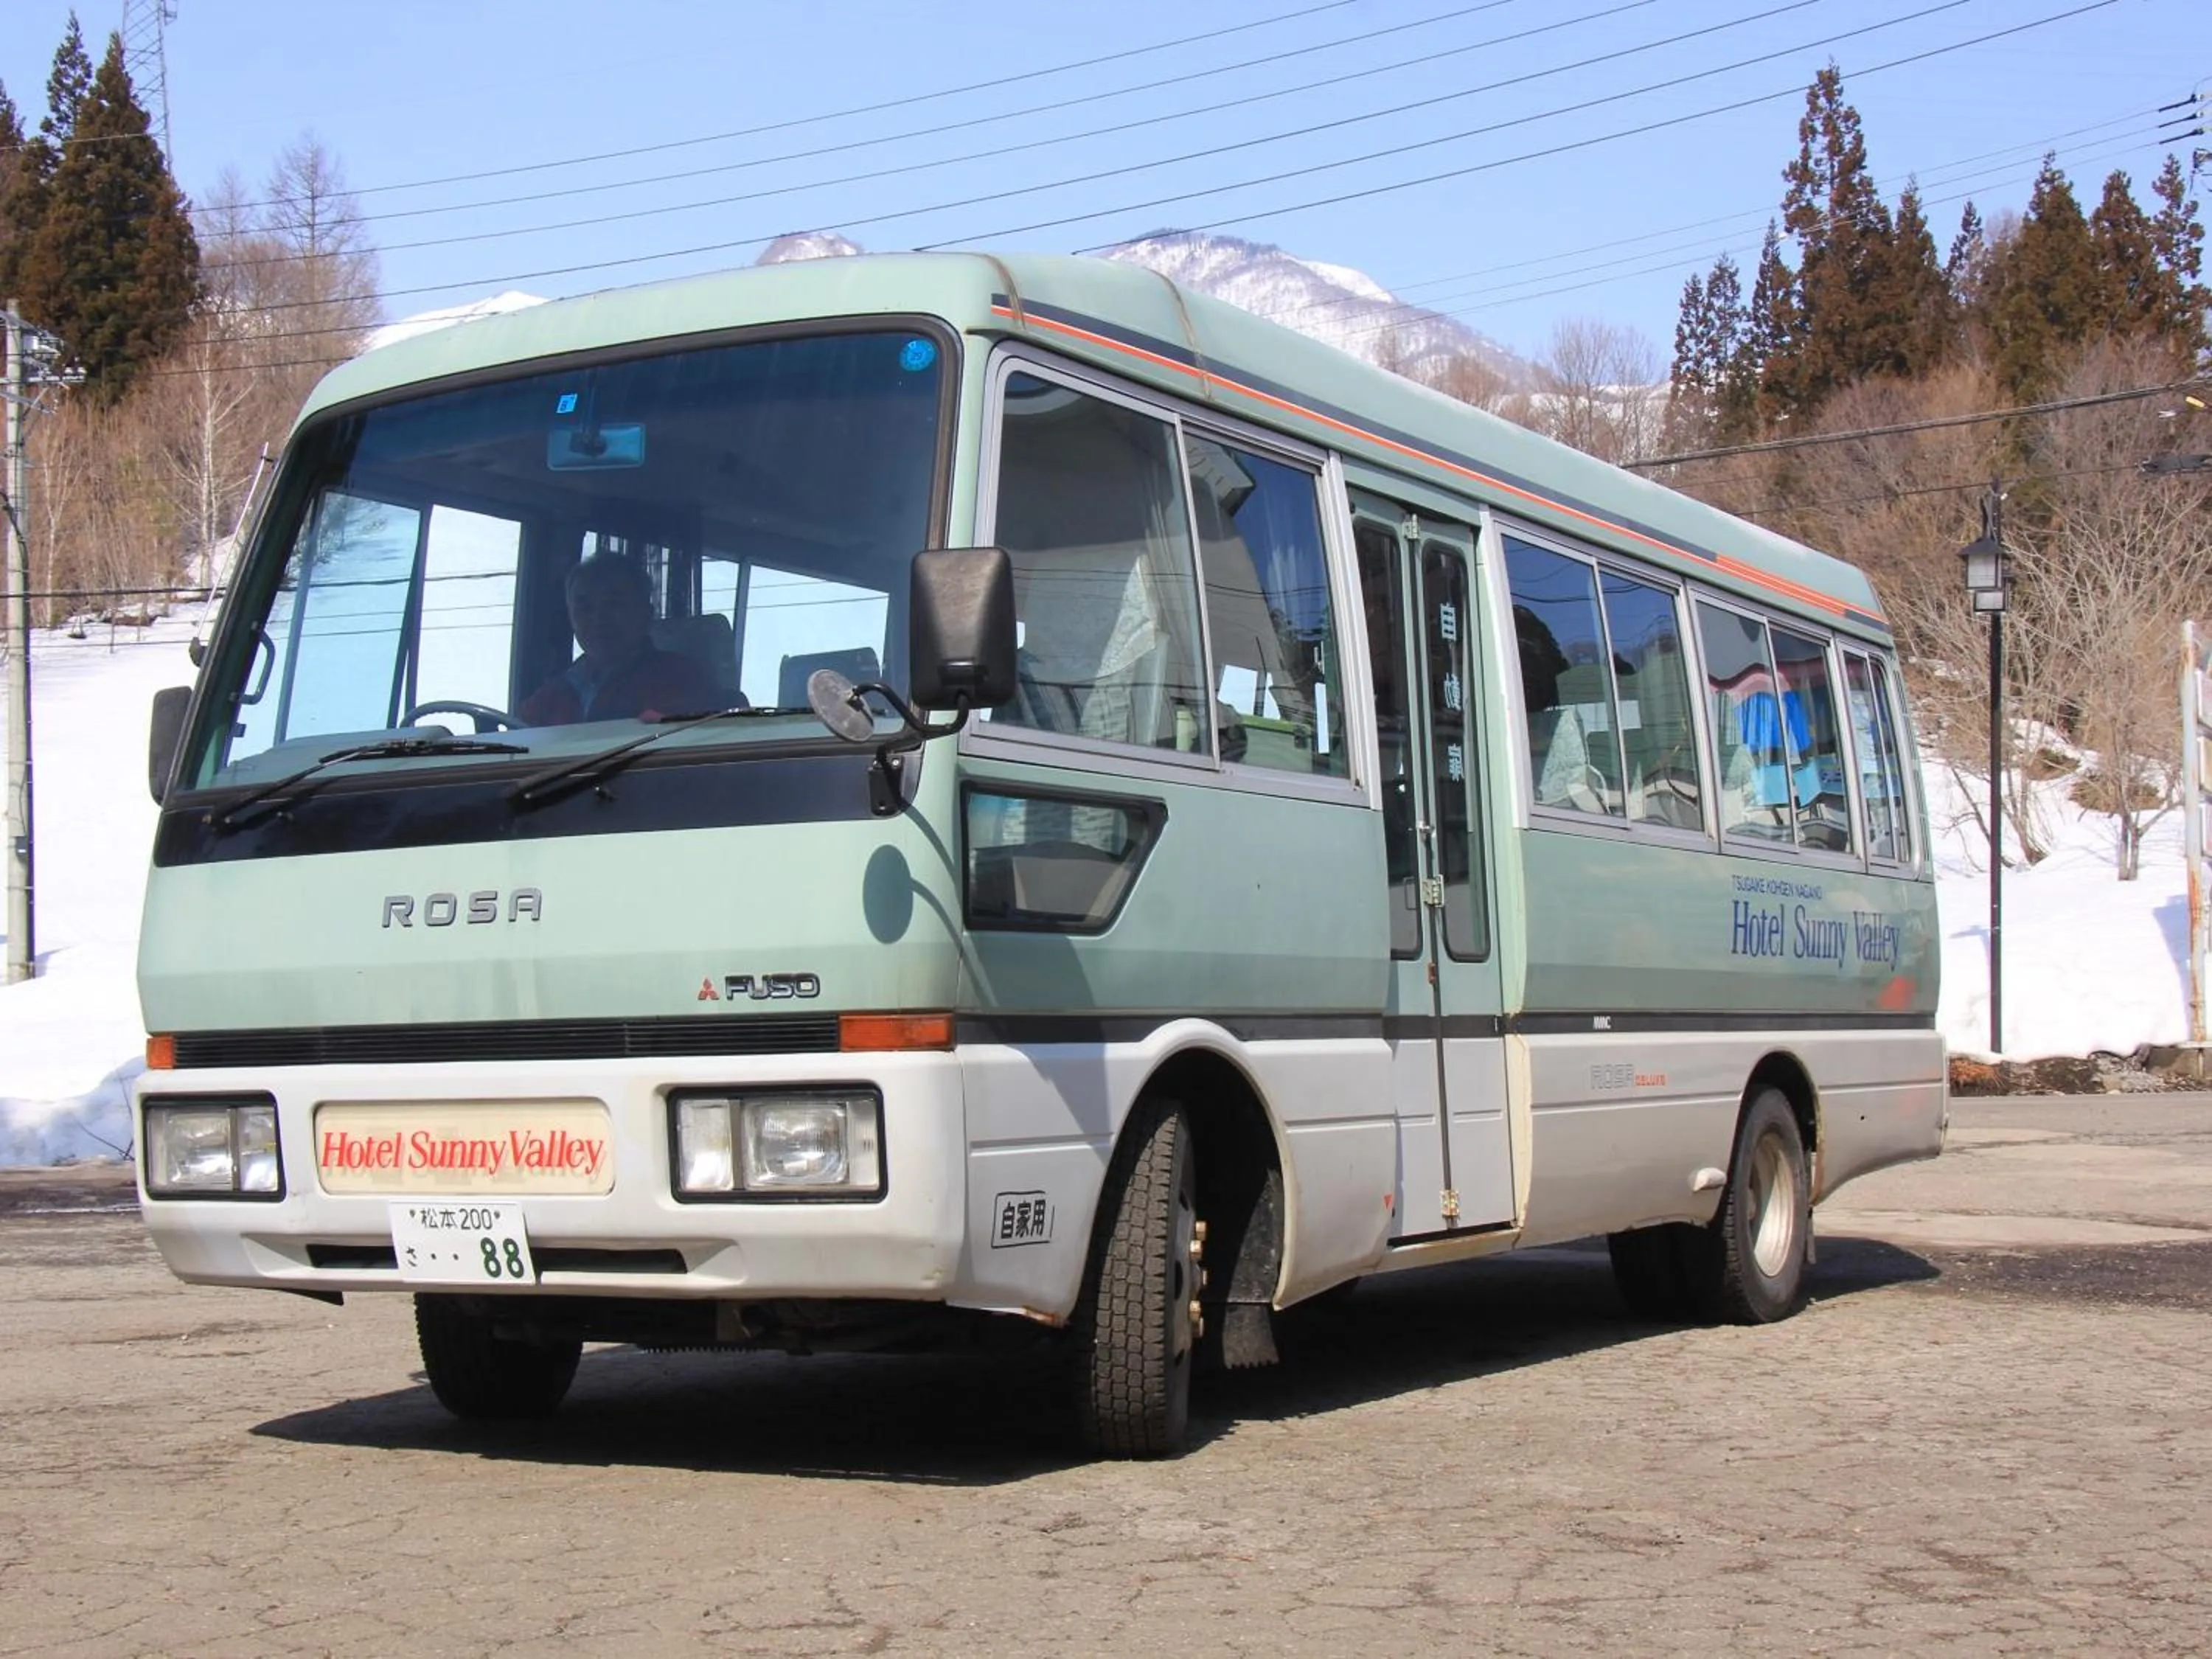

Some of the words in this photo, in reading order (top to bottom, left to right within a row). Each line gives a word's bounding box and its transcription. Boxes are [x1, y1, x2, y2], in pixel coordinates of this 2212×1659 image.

[382, 887, 543, 928] ROSA
[1731, 900, 1784, 958] Hotel
[1793, 904, 1848, 969] Sunny
[1853, 911, 1901, 972] Valley
[725, 973, 821, 1001] FUSO
[321, 1131, 403, 1169] Hotel
[408, 1130, 507, 1175] Sunny
[508, 1130, 605, 1175] Valley
[1001, 1199, 1046, 1239] 自家用
